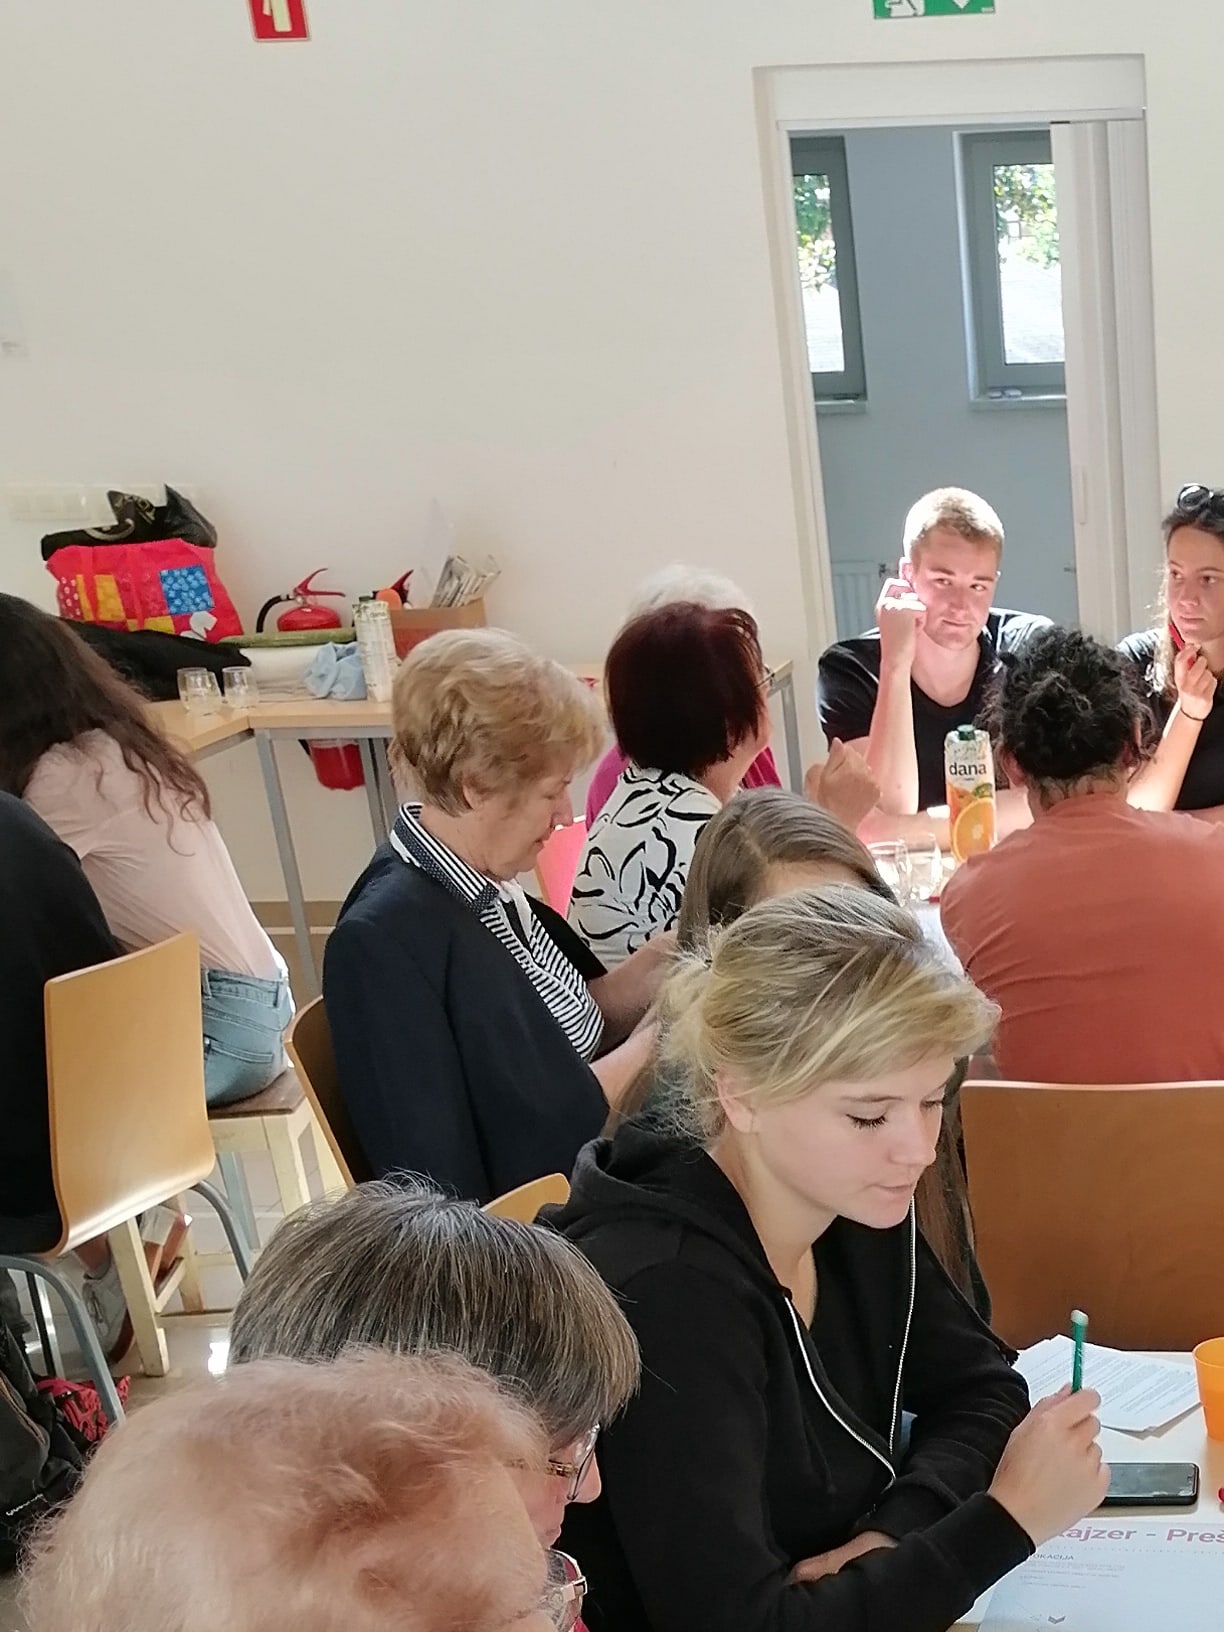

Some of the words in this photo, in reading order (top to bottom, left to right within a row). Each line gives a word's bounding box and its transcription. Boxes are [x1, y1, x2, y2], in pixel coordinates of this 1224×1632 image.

[949, 761, 987, 776] dana
[1059, 1526, 1137, 1542] ajzer
[1033, 1553, 1074, 1561] OKACIJA
